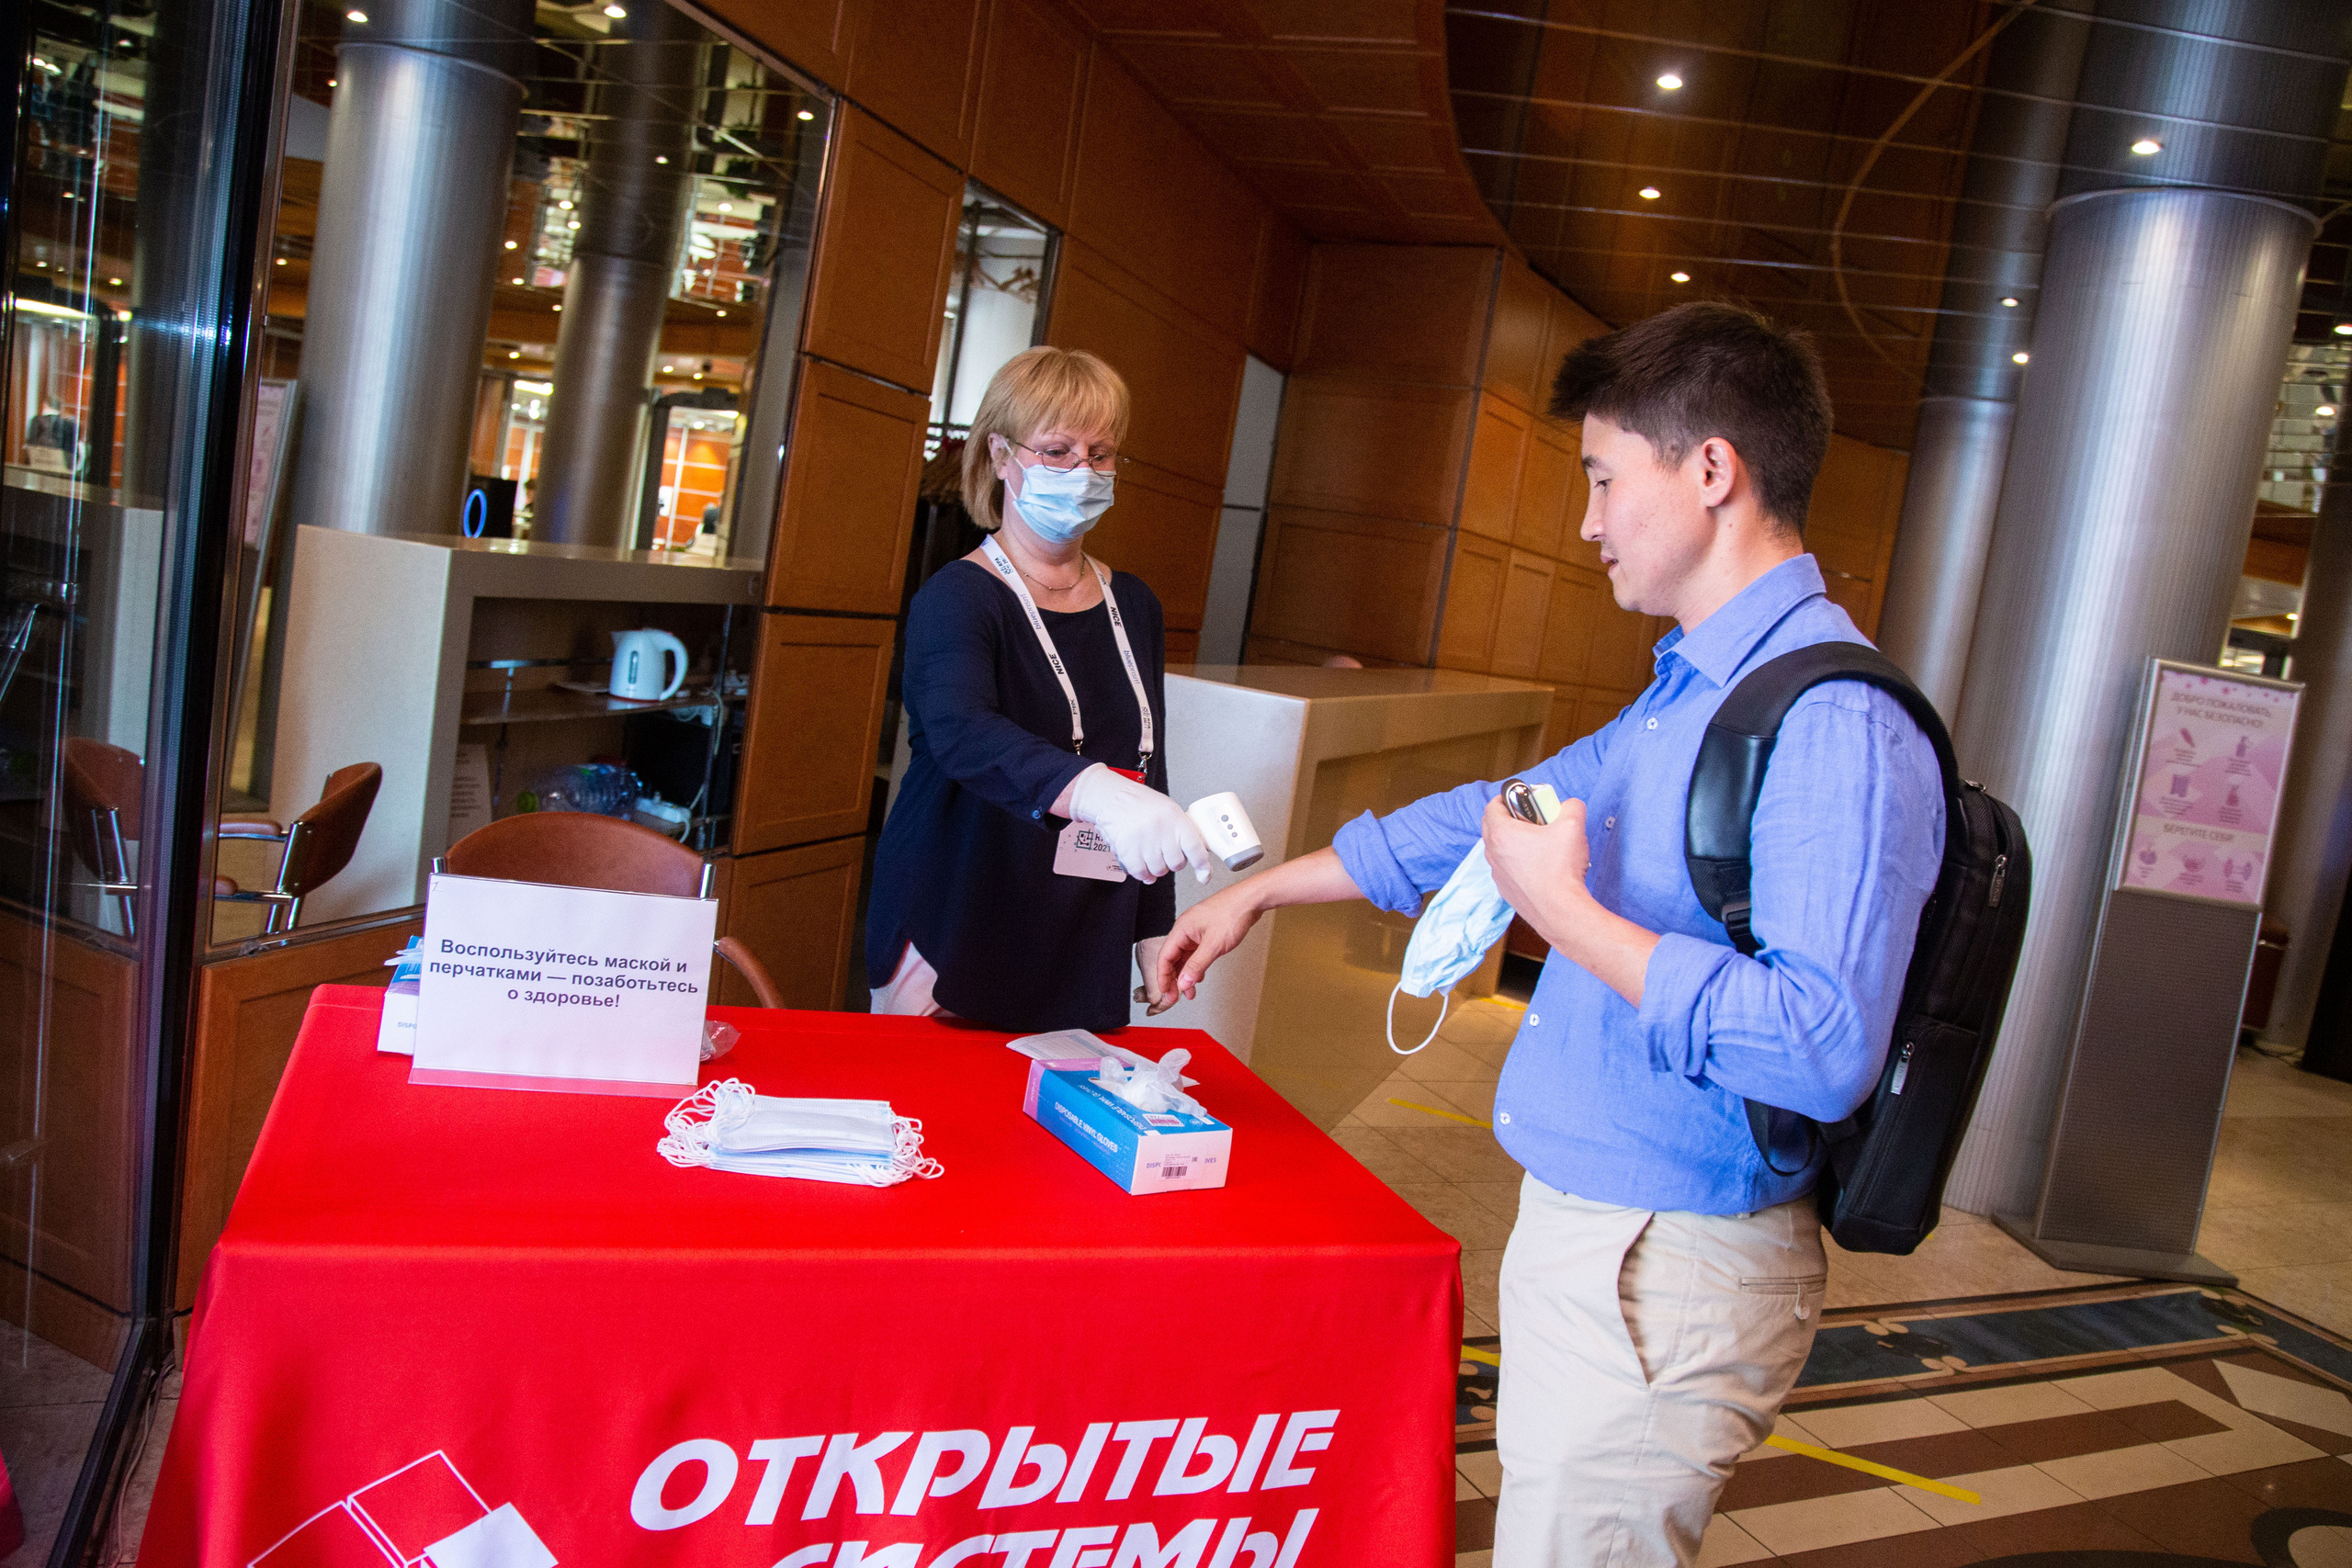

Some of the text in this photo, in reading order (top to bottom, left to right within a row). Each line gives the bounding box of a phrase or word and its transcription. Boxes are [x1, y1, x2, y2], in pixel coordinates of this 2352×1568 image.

[1110, 606, 1122, 627] NICE
[1049, 653, 1064, 675] NICE
[1123, 650, 1140, 684] blueprism
[2171, 692, 2204, 706] ДОБРО
[1093, 842, 1111, 852] 2021
[440, 939, 687, 974] Воспользуйтесь маской и
[429, 962, 542, 982] перчатками
[571, 972, 698, 994] позаботьтесь
[507, 988, 620, 1009] о здоровье!
[1054, 1101, 1085, 1128] DISPOSABLE
[1096, 1133, 1119, 1154] GLOVES
[629, 1409, 1340, 1531] ОТКРЫТЫЕ
